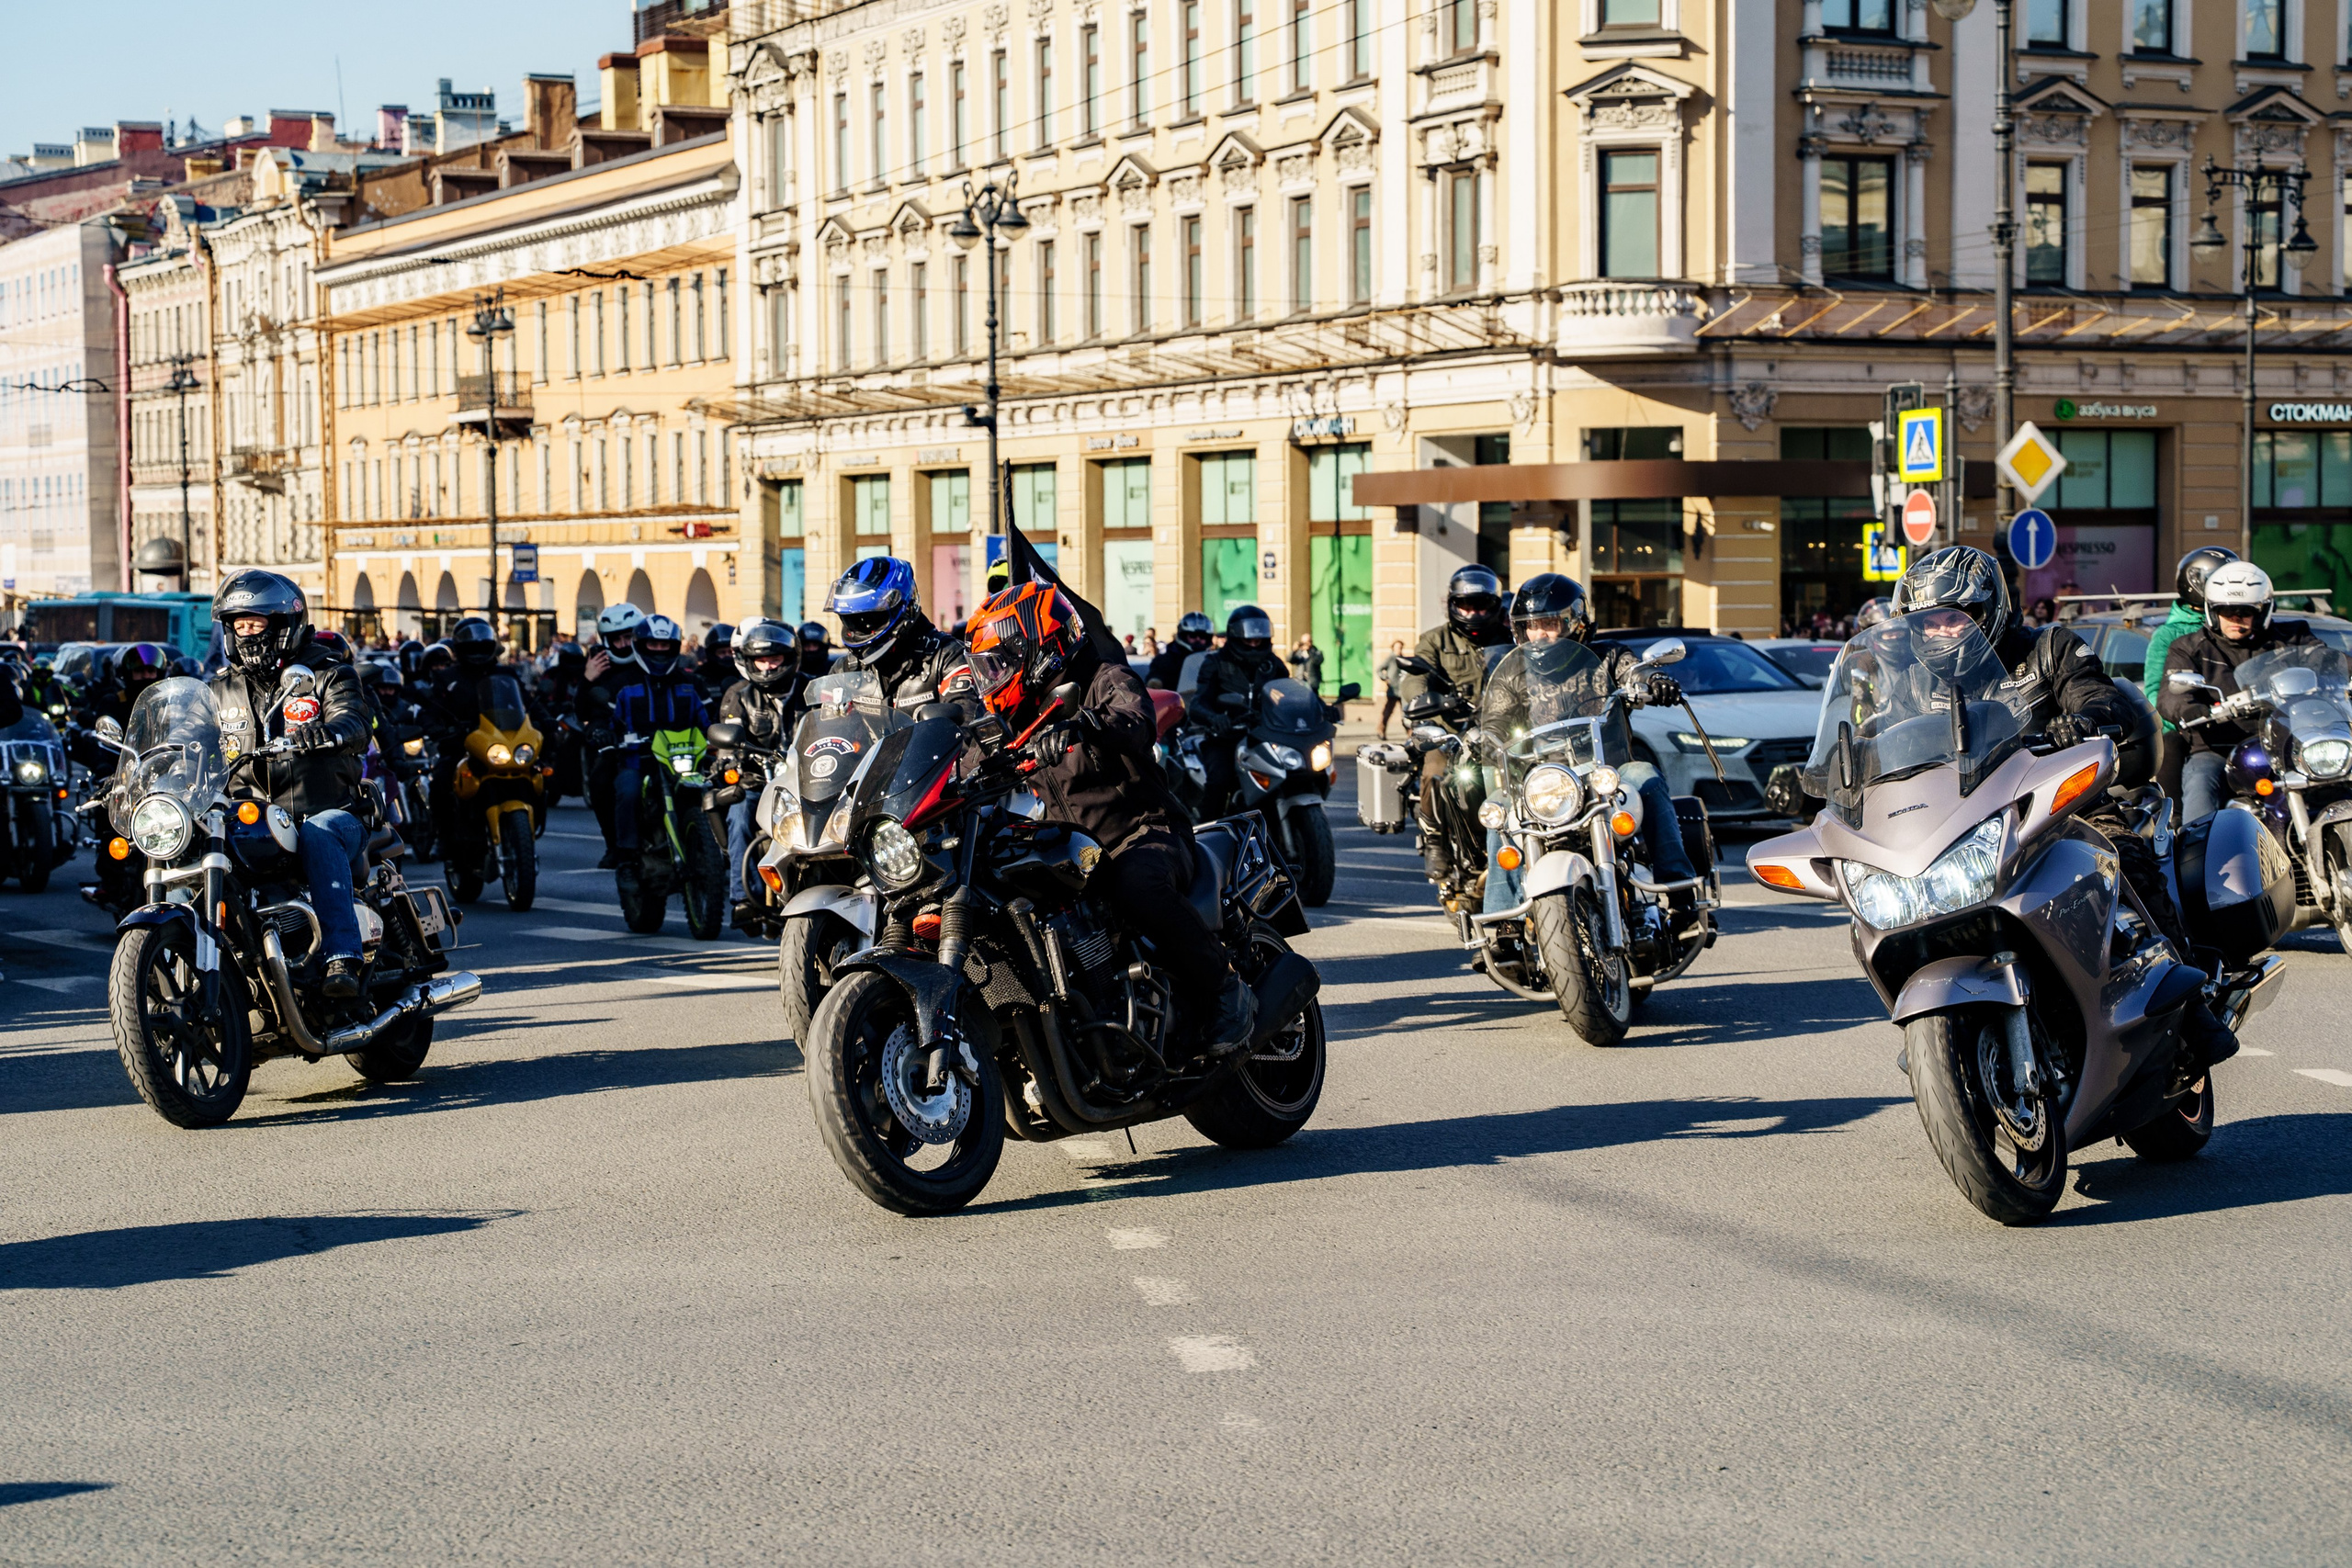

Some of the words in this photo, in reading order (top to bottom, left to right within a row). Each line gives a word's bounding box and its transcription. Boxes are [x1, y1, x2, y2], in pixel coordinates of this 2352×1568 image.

[2079, 401, 2120, 420] азбука
[2122, 404, 2157, 420] вкуса
[1908, 598, 1938, 612] SHARK
[2001, 674, 2033, 688] MEMBER
[899, 694, 933, 705] TREASURER
[1888, 803, 1928, 818] HONDA
